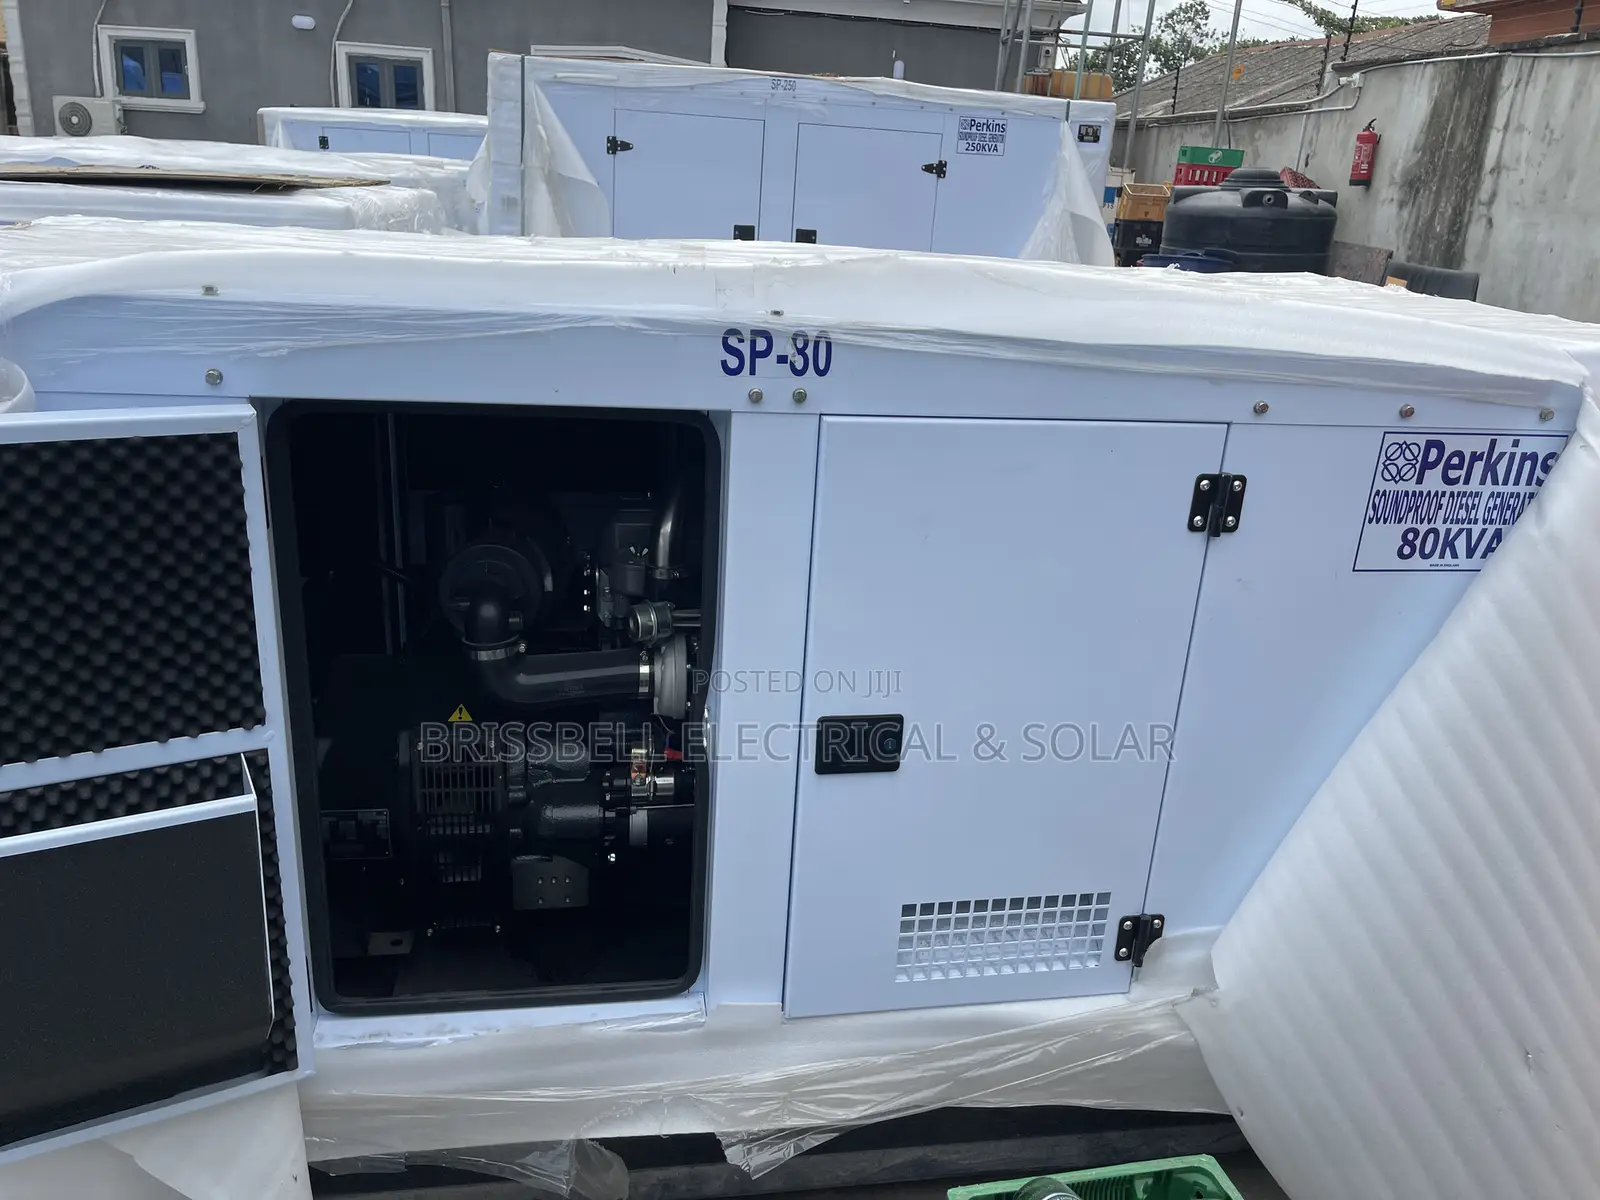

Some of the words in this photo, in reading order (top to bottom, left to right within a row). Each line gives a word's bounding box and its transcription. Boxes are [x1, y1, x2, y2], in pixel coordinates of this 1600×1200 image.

[770, 79, 796, 92] SP-250
[969, 119, 1006, 133] Perkins
[964, 142, 998, 153] 250KVA
[720, 328, 832, 377] SP-80
[1415, 438, 1561, 487] Perkins
[1367, 489, 1446, 525] SOUNDPROOF
[1442, 490, 1484, 526] DIESEL
[1396, 527, 1503, 560] 80KVA
